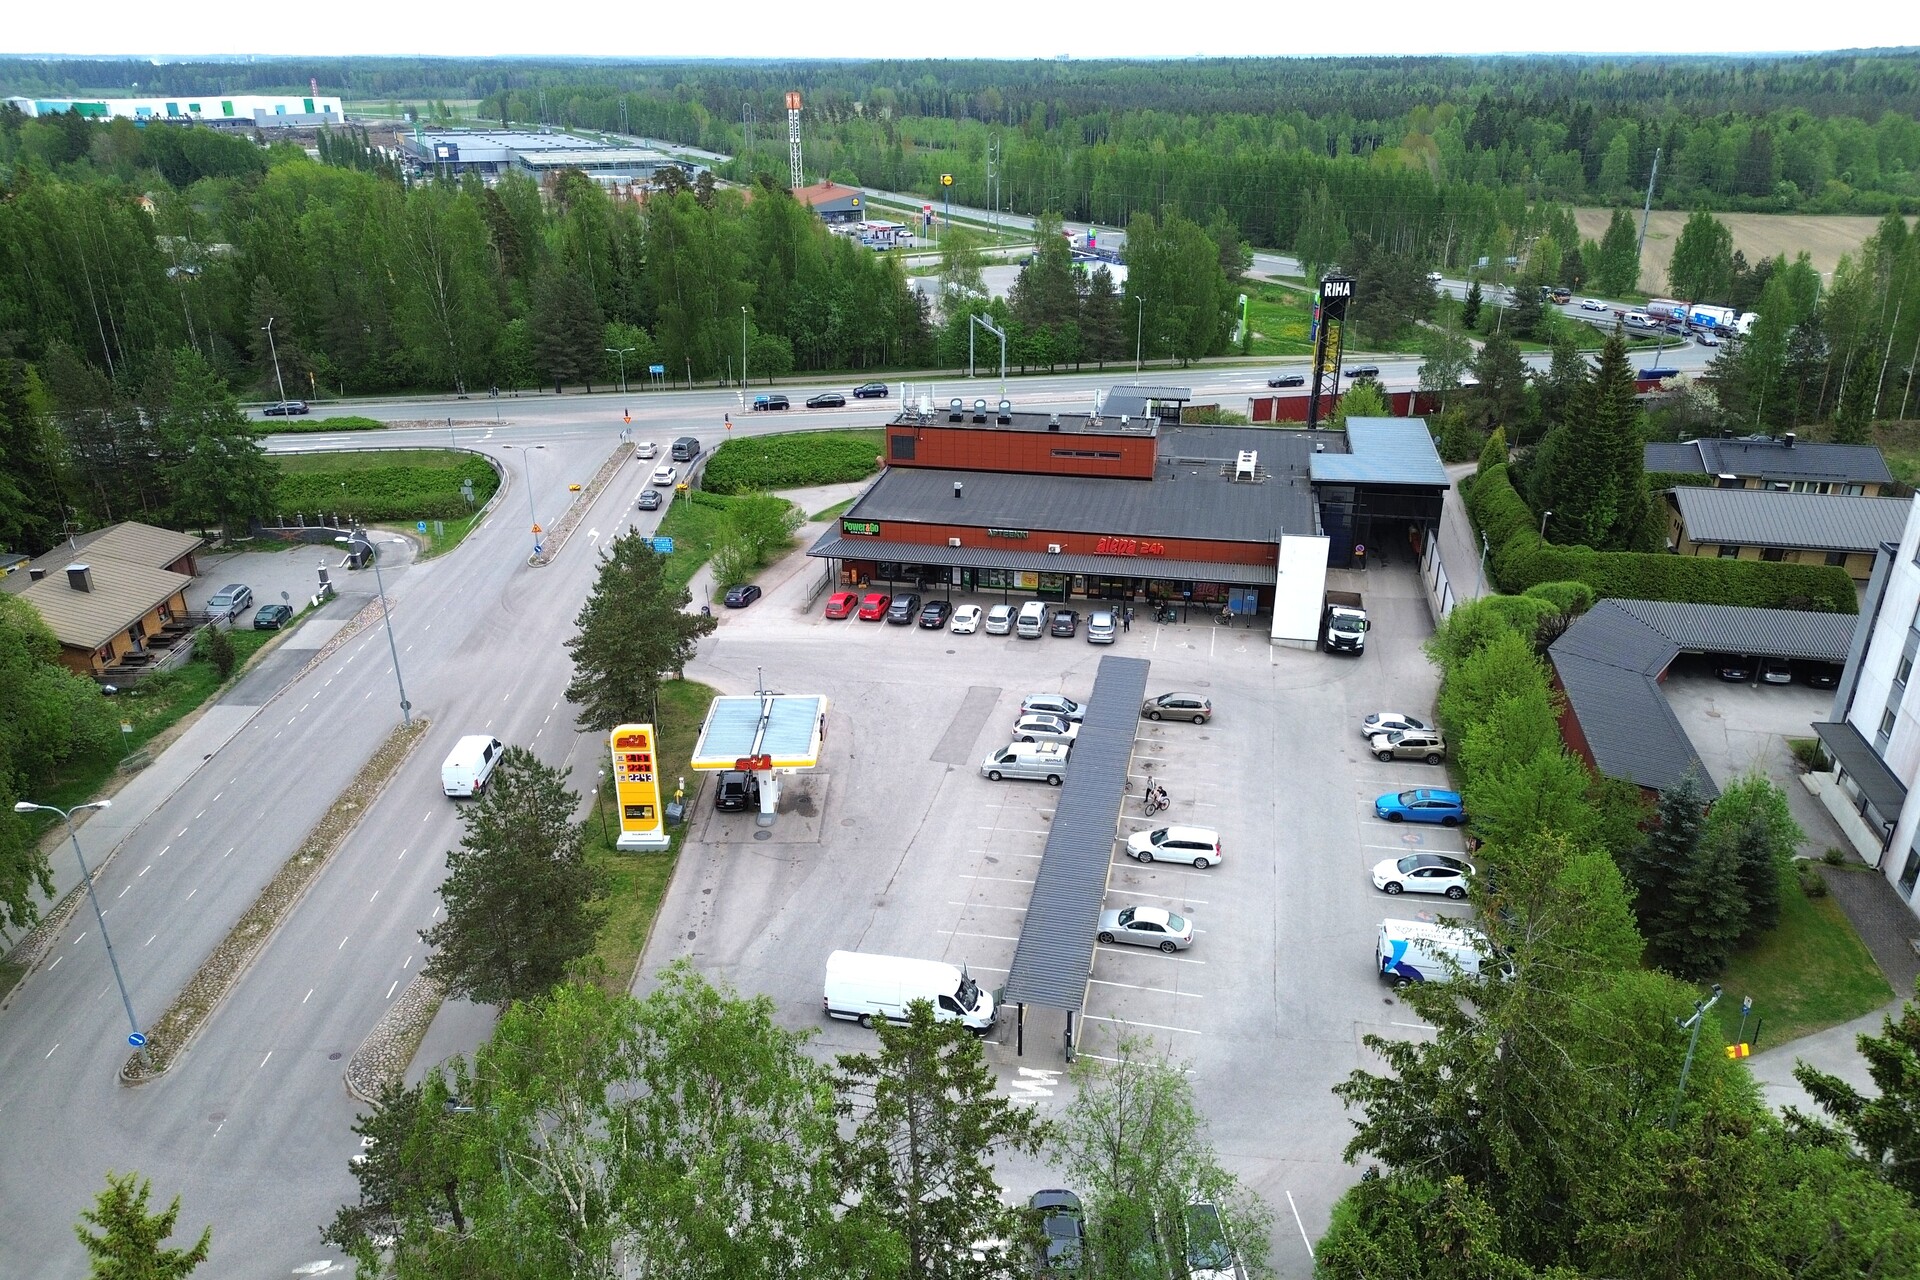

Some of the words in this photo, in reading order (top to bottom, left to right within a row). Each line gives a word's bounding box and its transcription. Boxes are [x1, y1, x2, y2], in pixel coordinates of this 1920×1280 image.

[1324, 281, 1350, 297] RIHA
[843, 521, 879, 533] Power&Go
[1095, 536, 1137, 556] alepa
[1140, 542, 1165, 555] 24h
